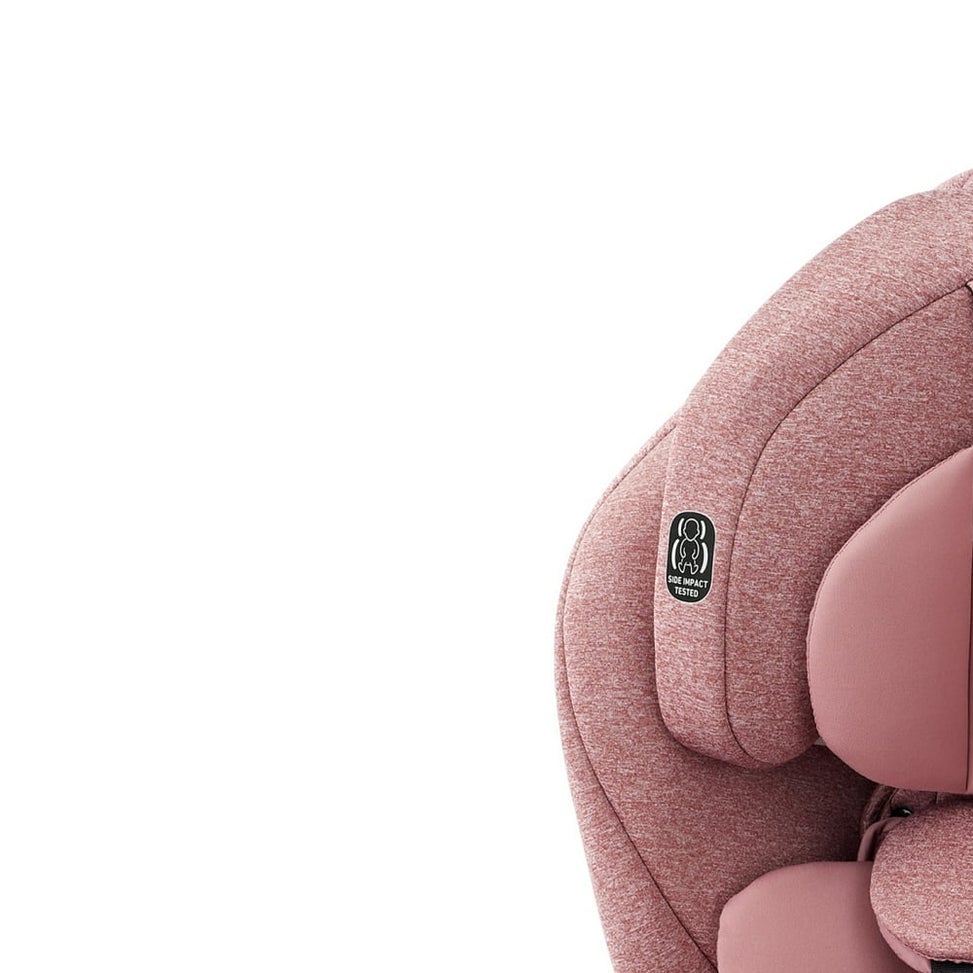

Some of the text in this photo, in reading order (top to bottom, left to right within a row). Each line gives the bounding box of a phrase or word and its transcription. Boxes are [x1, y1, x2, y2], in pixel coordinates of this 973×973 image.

[667, 574, 709, 589] SIDE IMPACT
[674, 586, 699, 598] TESTED
